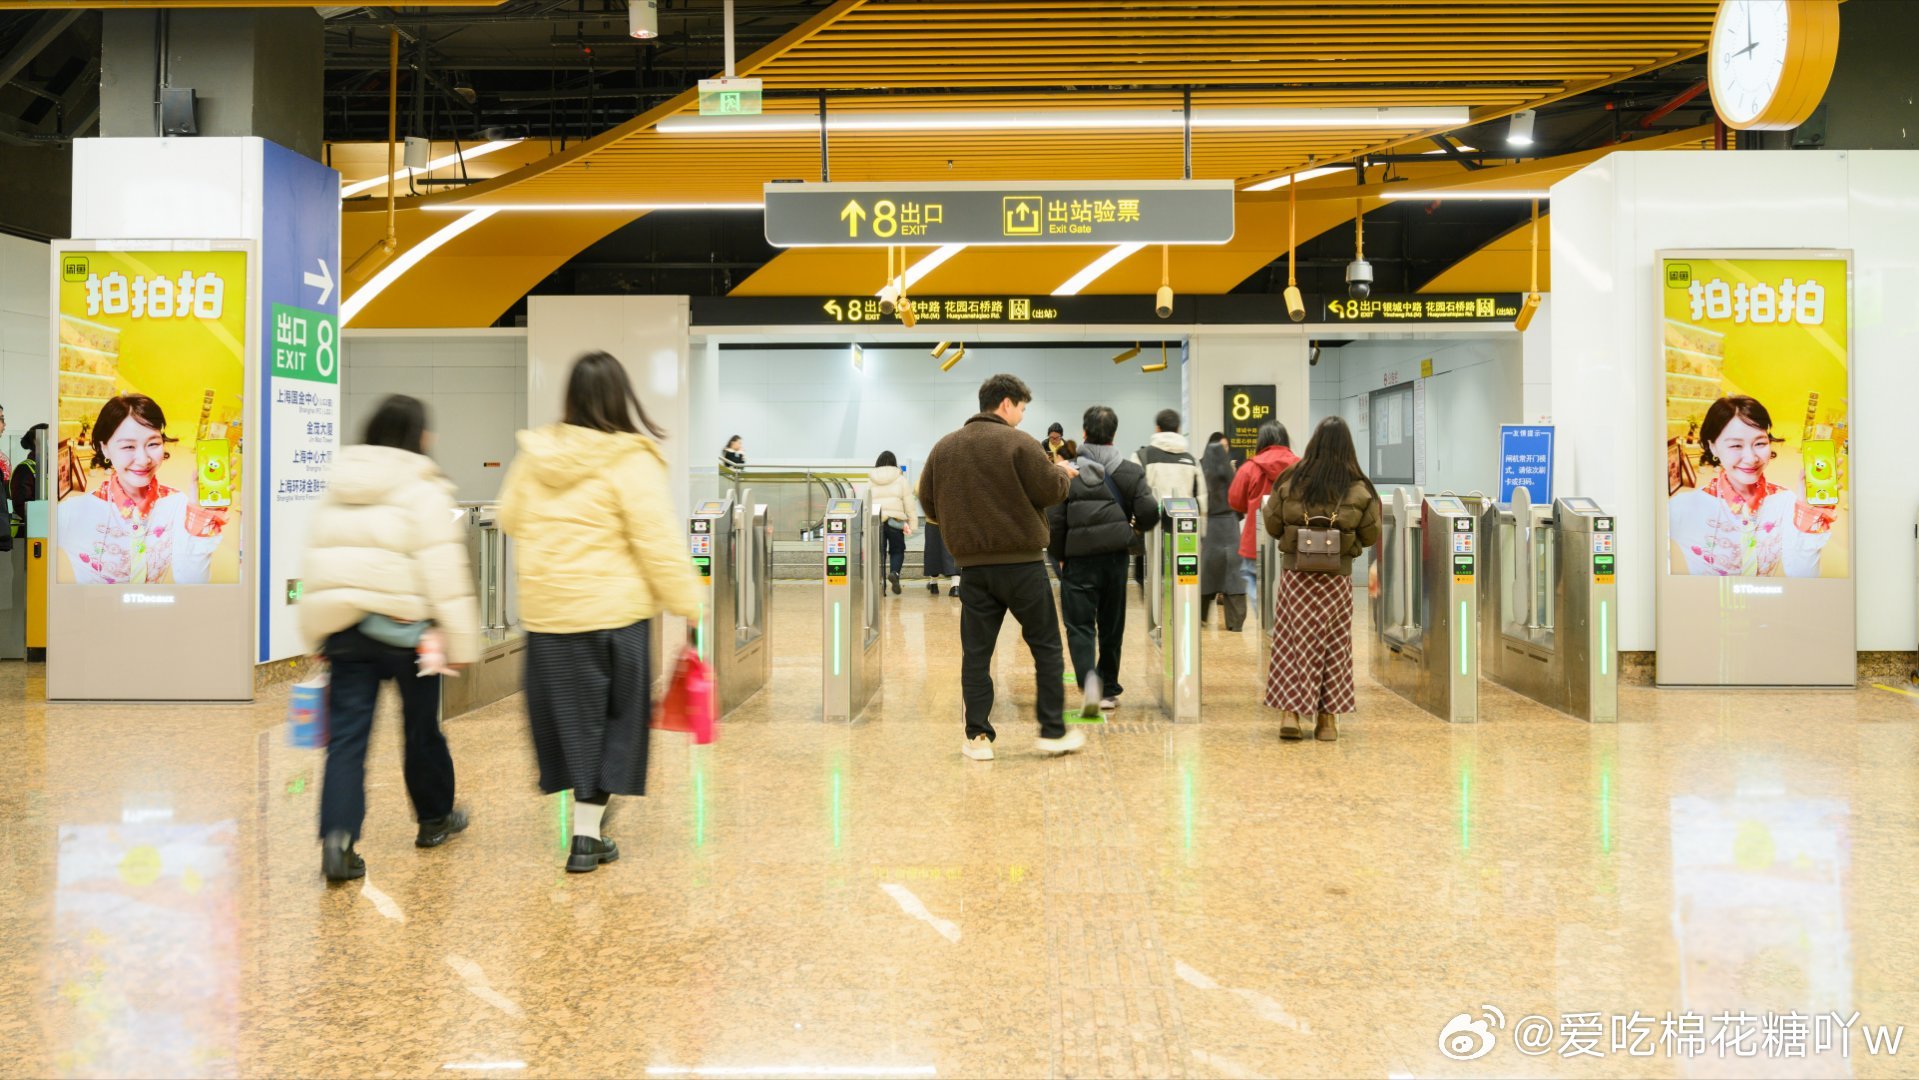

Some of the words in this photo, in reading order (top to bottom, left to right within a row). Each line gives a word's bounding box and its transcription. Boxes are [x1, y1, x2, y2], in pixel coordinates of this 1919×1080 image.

[872, 200, 898, 237] 8
[901, 203, 943, 225] 出口
[1047, 199, 1141, 223] 出站验票
[901, 225, 927, 236] EXIT
[1049, 224, 1066, 234] Exit
[1069, 224, 1092, 235] Gate
[85, 269, 224, 320] 拍拍拍
[1688, 277, 1825, 326] 拍拍拍
[847, 300, 862, 321] 8
[945, 301, 1003, 312] 花园石桥路
[865, 313, 880, 321] EXIT
[1346, 300, 1359, 319] 8
[1360, 301, 1381, 311] 出口
[1383, 302, 1422, 312] 银城中路
[1426, 302, 1475, 312] 花园石桥路
[277, 312, 307, 347] 出口
[316, 319, 334, 377] 8
[277, 348, 307, 372] EXIT
[276, 389, 319, 406] 上海国金中心
[1232, 393, 1250, 420] 8
[1253, 405, 1269, 414] 出口
[306, 421, 333, 436] 金茂大厦
